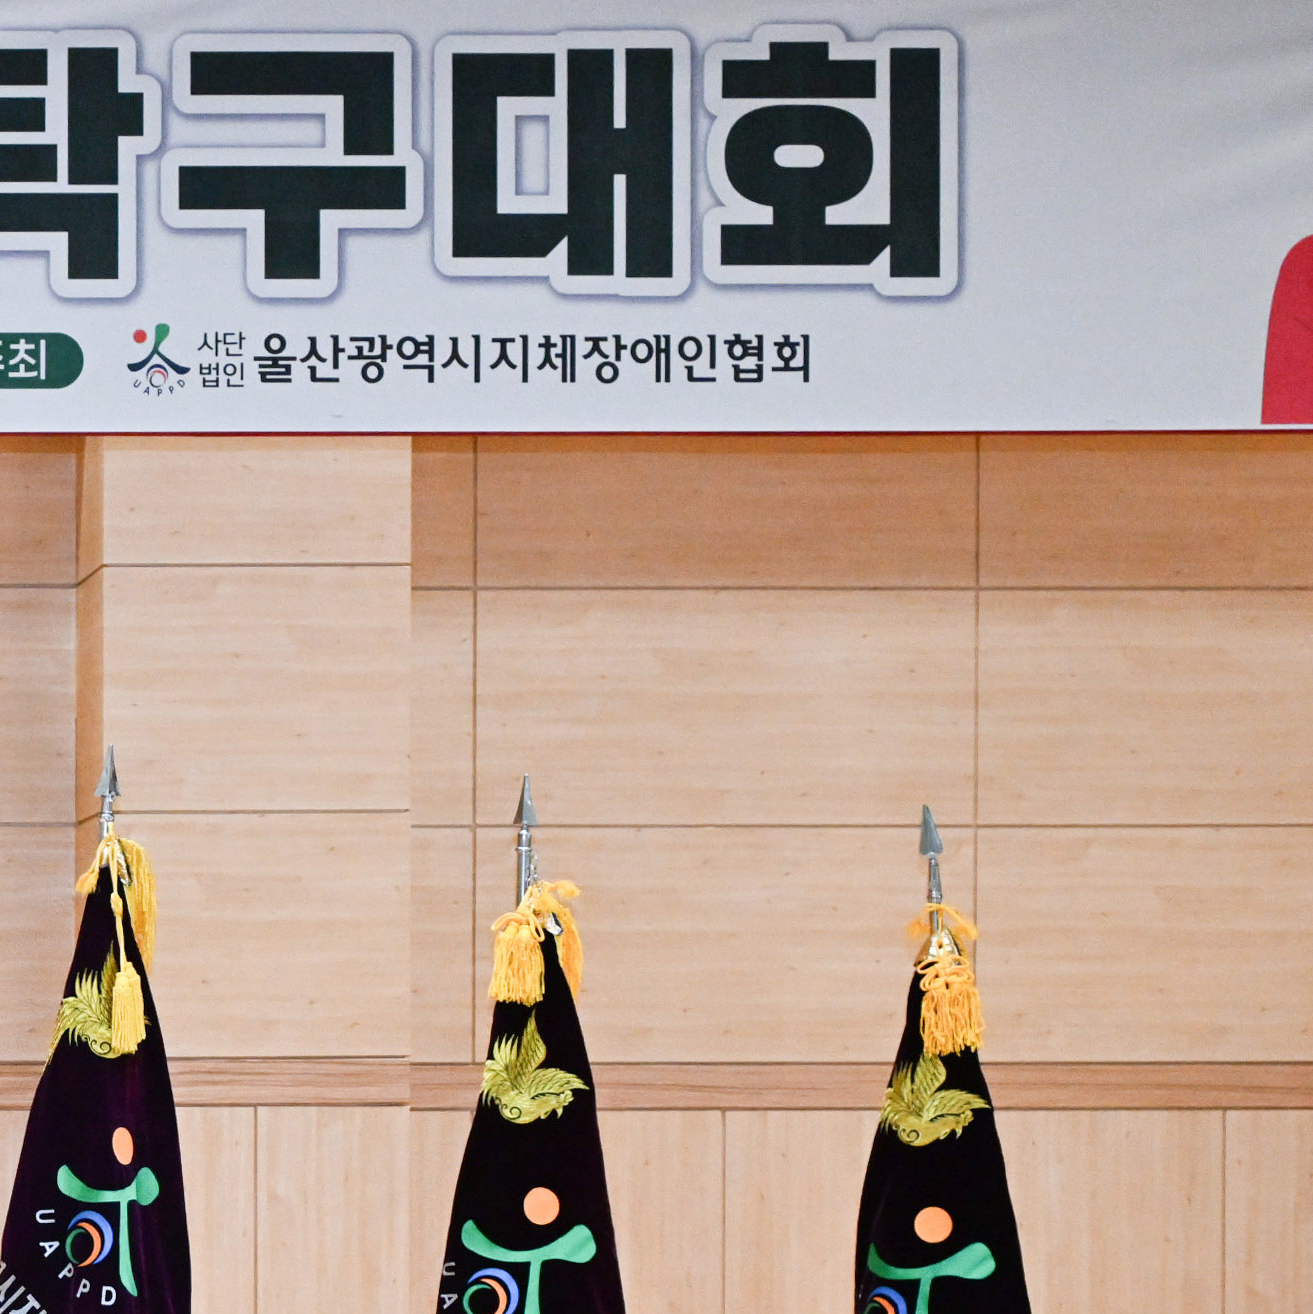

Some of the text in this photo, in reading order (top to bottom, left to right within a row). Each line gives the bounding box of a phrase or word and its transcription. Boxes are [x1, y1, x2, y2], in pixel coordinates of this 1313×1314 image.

[197, 331, 246, 357] 사단
[252, 332, 811, 385] 울산광역시지체장애인협회
[198, 361, 245, 388] 법인
[35, 1208, 117, 1307] UAPPD
